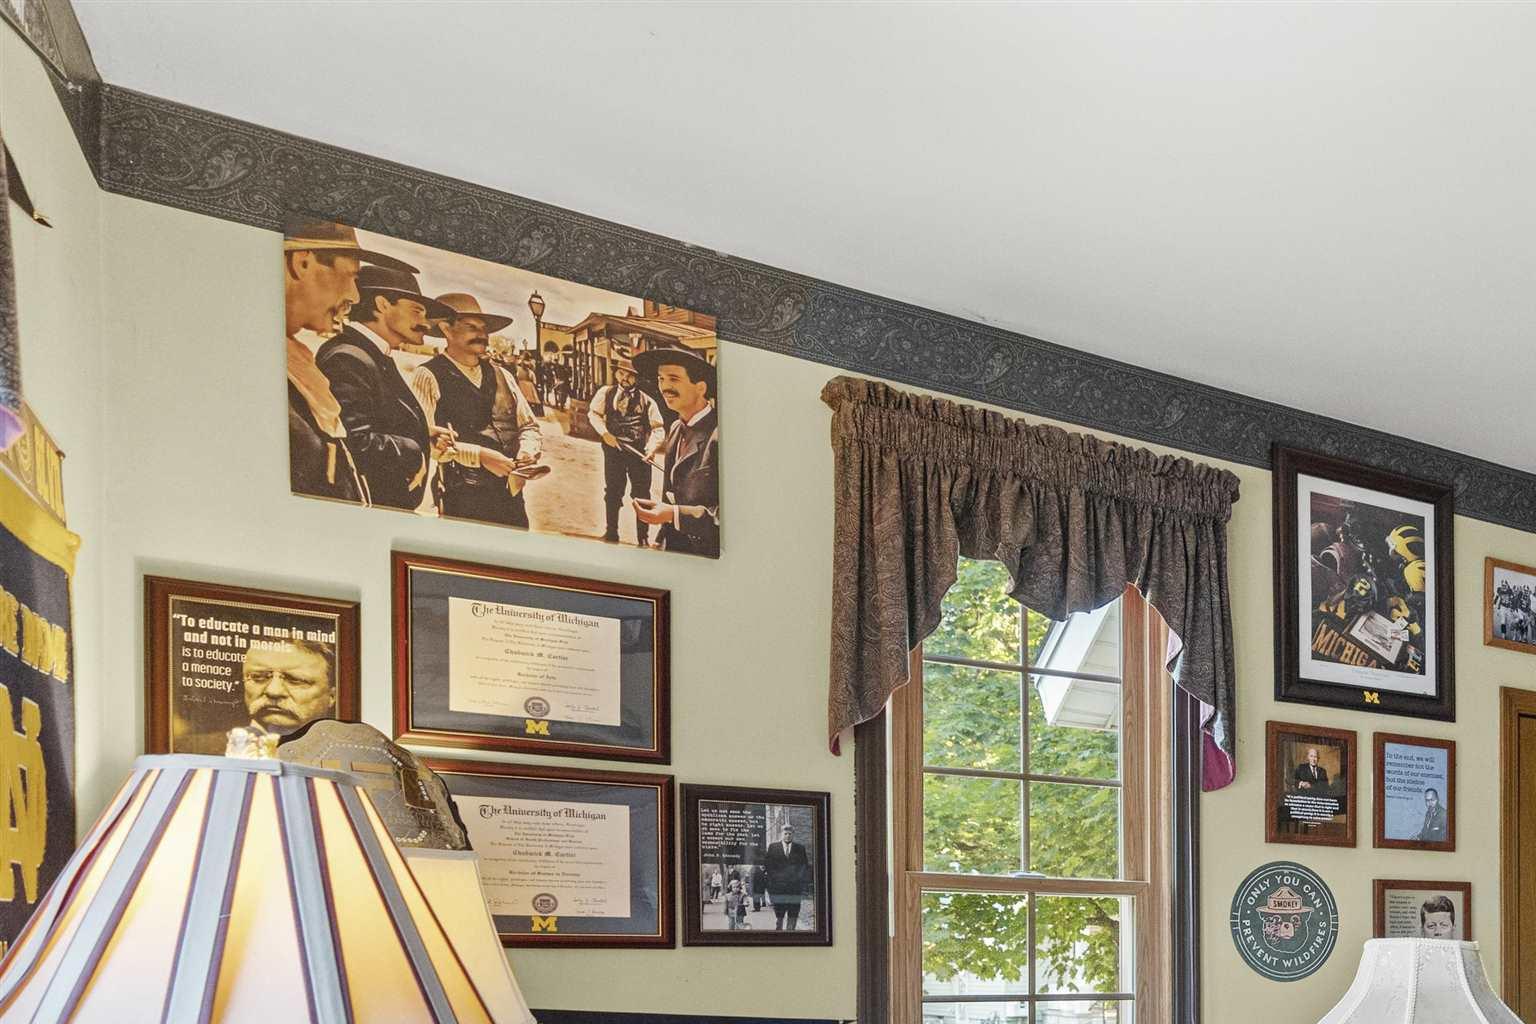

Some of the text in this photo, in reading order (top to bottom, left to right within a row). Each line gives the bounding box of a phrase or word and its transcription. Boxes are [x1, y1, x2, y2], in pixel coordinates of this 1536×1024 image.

[472, 602, 600, 628] The University of Michigan
[199, 617, 249, 633] educate
[252, 624, 260, 635] a
[263, 625, 289, 638] man
[292, 626, 303, 640] in
[306, 629, 336, 644] mind
[184, 631, 208, 644] and
[211, 633, 232, 646] not
[235, 635, 247, 648] in
[182, 646, 247, 663] is to educate
[182, 662, 232, 676] a menace
[182, 676, 193, 687] to
[1363, 690, 1381, 704] M
[525, 719, 550, 736] M
[479, 804, 607, 820] The University of Michigan
[1247, 875, 1323, 908] ONLY YOU CAN
[1273, 900, 1298, 908] SMOKEY
[531, 915, 558, 932] M
[1242, 919, 1280, 967] PREVENT
